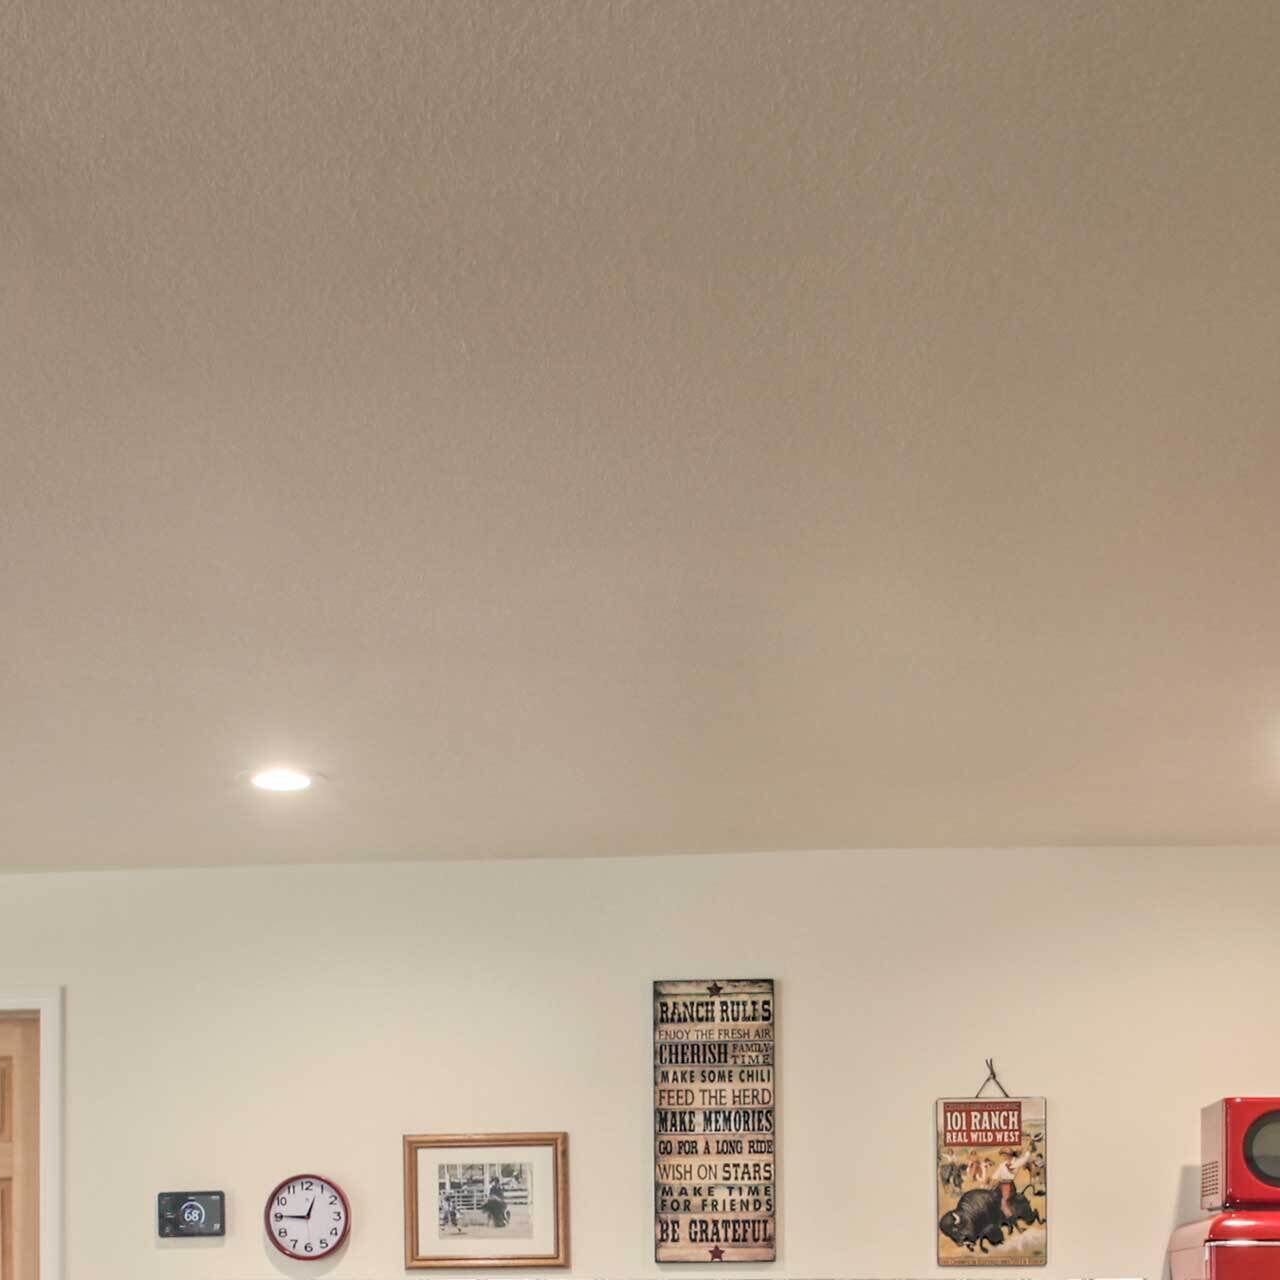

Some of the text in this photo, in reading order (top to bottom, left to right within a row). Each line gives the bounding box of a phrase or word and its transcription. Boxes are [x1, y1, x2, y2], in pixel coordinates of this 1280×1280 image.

[659, 1000, 772, 1023] RANCH RULES
[658, 1028, 771, 1040] ENJOY THE FRESH AIR
[659, 1043, 770, 1064] CHERISH FAMILY
[731, 1055, 770, 1065] TIME
[660, 1070, 771, 1083] MAKE SOME CHILI
[658, 1088, 772, 1106] FEED THE HERD
[658, 1110, 773, 1133] MAKE MEMORIES
[946, 1110, 1019, 1130] 101 RANCH
[946, 1131, 1020, 1143] REAL WILD WEST
[658, 1140, 773, 1155] GO FOR A LONG RIDE
[657, 1163, 773, 1180] WISH ON STARS
[301, 1181, 313, 1191] 12
[661, 1186, 771, 1197] MAKE TIME
[277, 1196, 287, 1206] 10
[329, 1195, 338, 1205] 2
[661, 1199, 773, 1211] FOR FRIENDS
[332, 1211, 342, 1221] 3
[278, 1228, 288, 1238] 8
[329, 1227, 338, 1236] 4
[659, 1219, 771, 1243] BE GRATEFUL
[290, 1239, 298, 1249] 7
[304, 1242, 313, 1252] 6
[320, 1239, 329, 1249] 5
